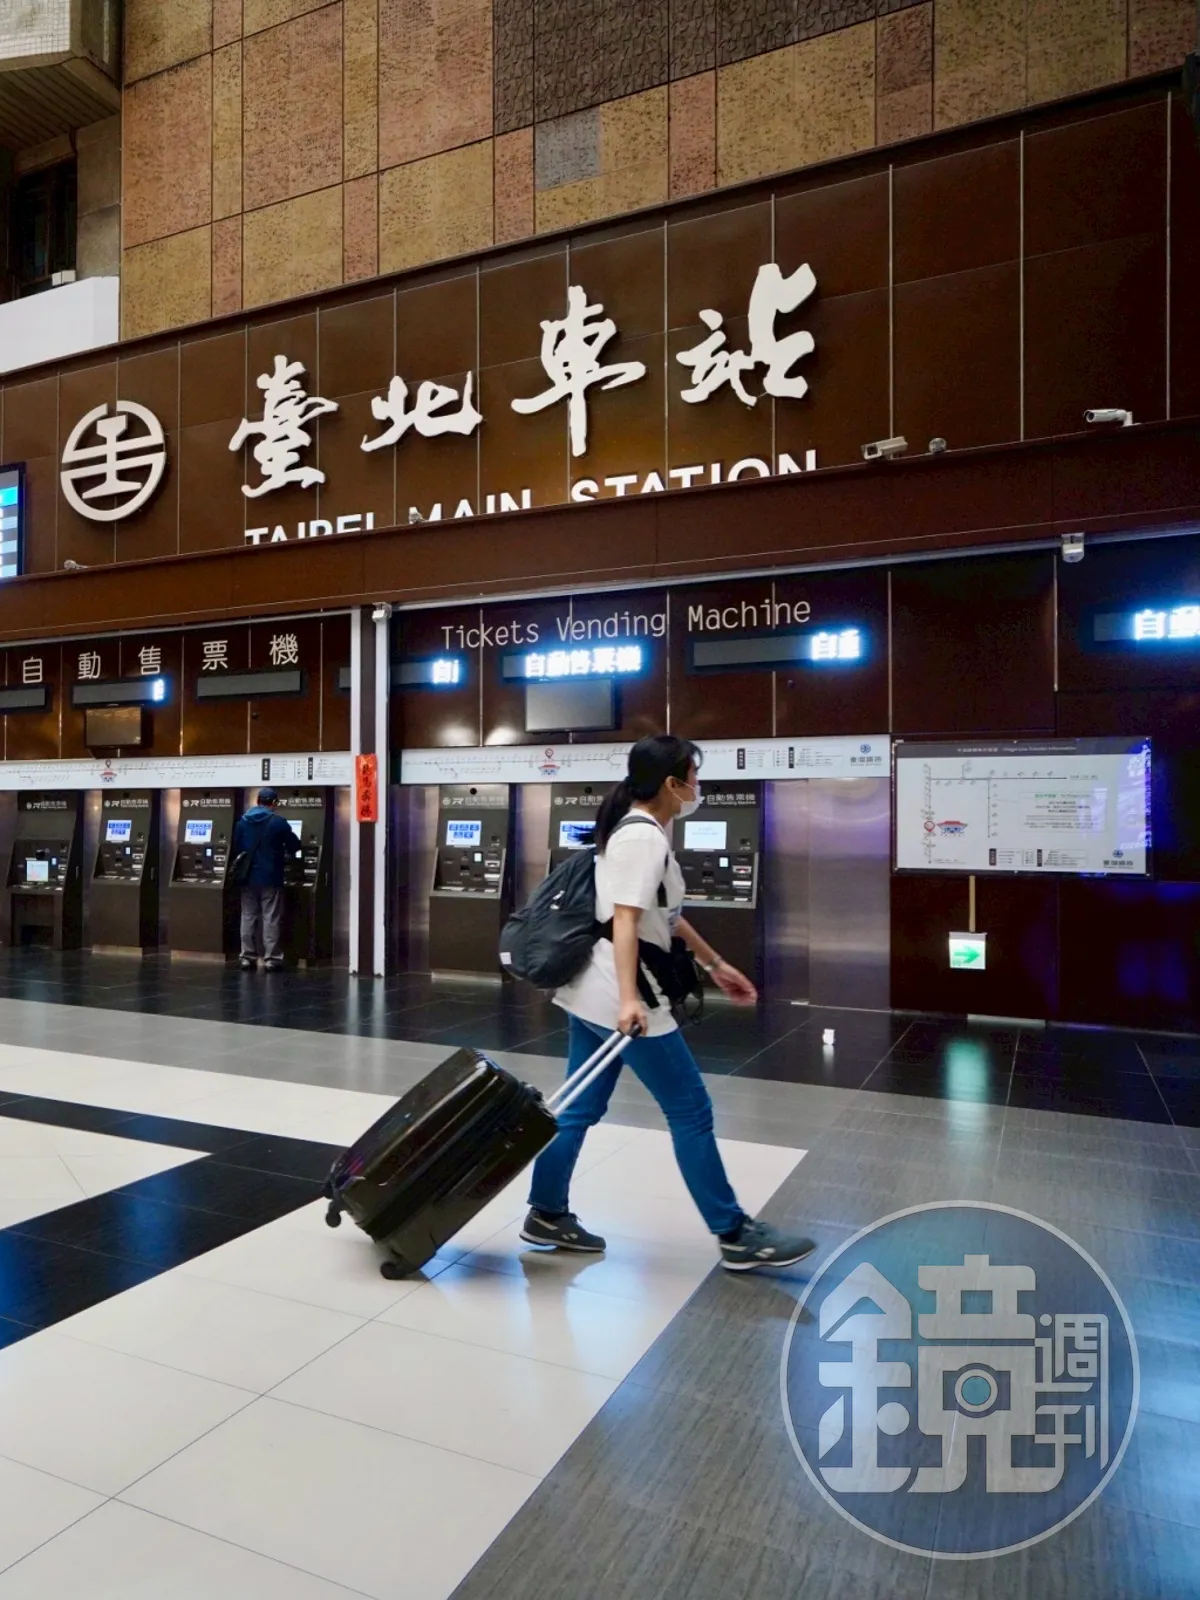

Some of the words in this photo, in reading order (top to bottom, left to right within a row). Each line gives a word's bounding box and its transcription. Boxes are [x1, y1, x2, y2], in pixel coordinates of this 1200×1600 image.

[228, 263, 817, 499] 臺北車站
[441, 620, 539, 650] Tickets
[556, 610, 667, 642] Vending
[688, 599, 811, 631] Machine
[22, 633, 299, 685] 自動售票機
[579, 795, 604, 803] 自動售
